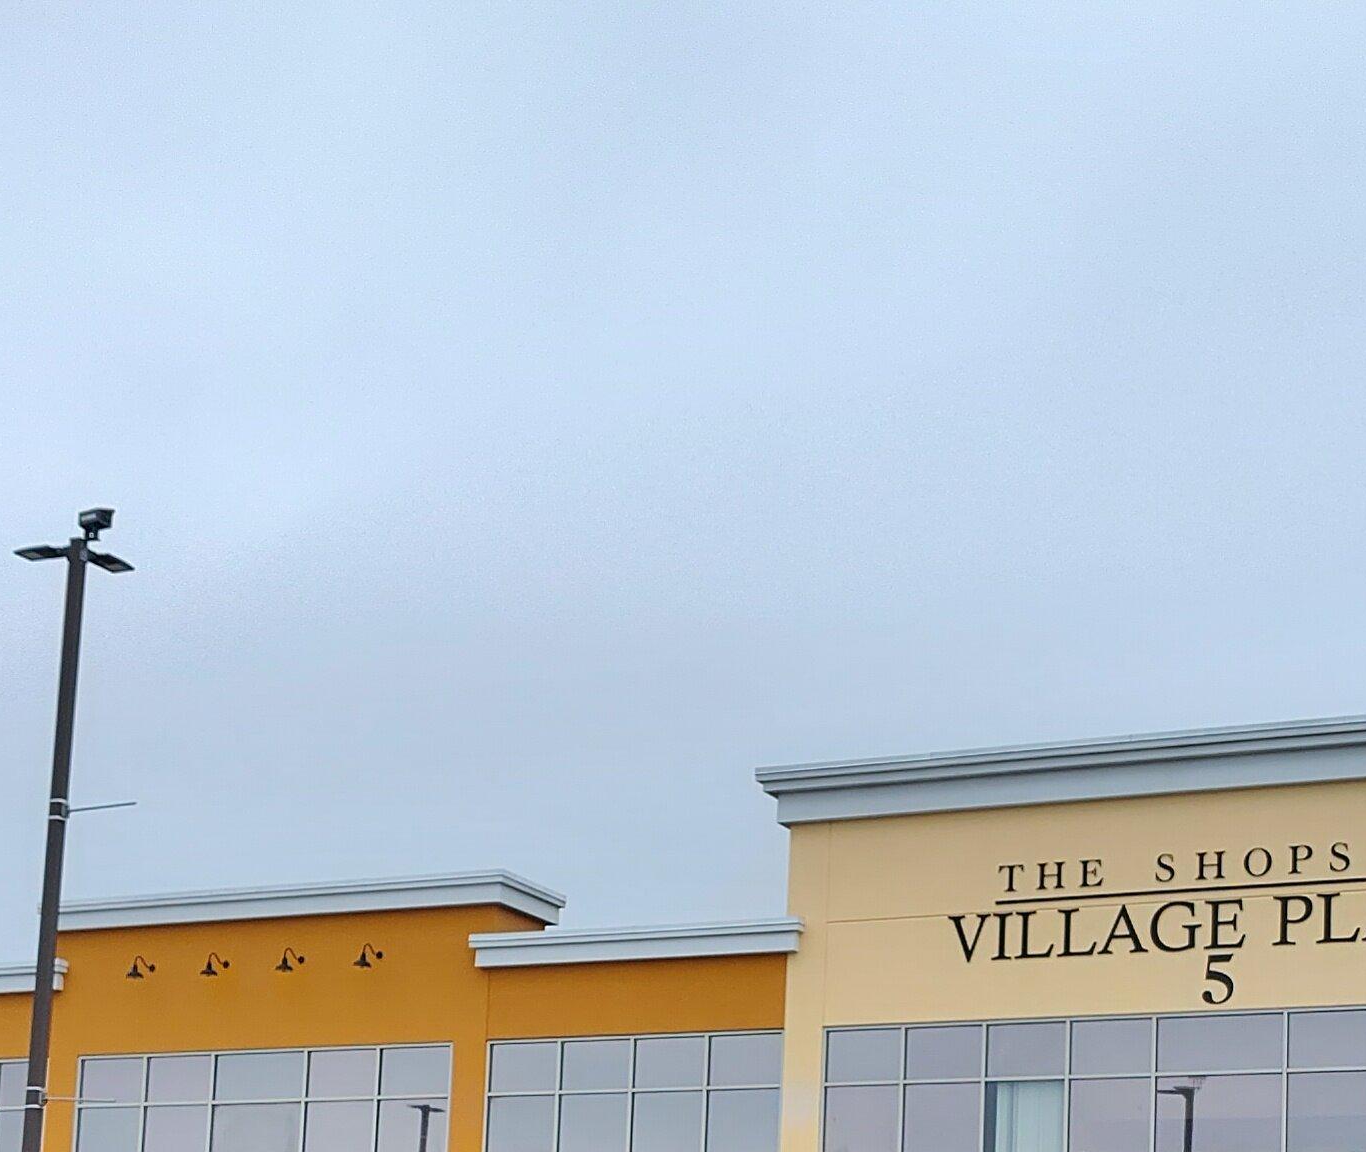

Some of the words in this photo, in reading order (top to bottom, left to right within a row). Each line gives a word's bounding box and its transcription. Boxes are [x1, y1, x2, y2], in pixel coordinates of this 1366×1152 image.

[998, 858, 1105, 893] THE
[1155, 841, 1352, 883] SHOPS
[948, 898, 1246, 963] VILLAGE
[1201, 954, 1234, 1004] 5
